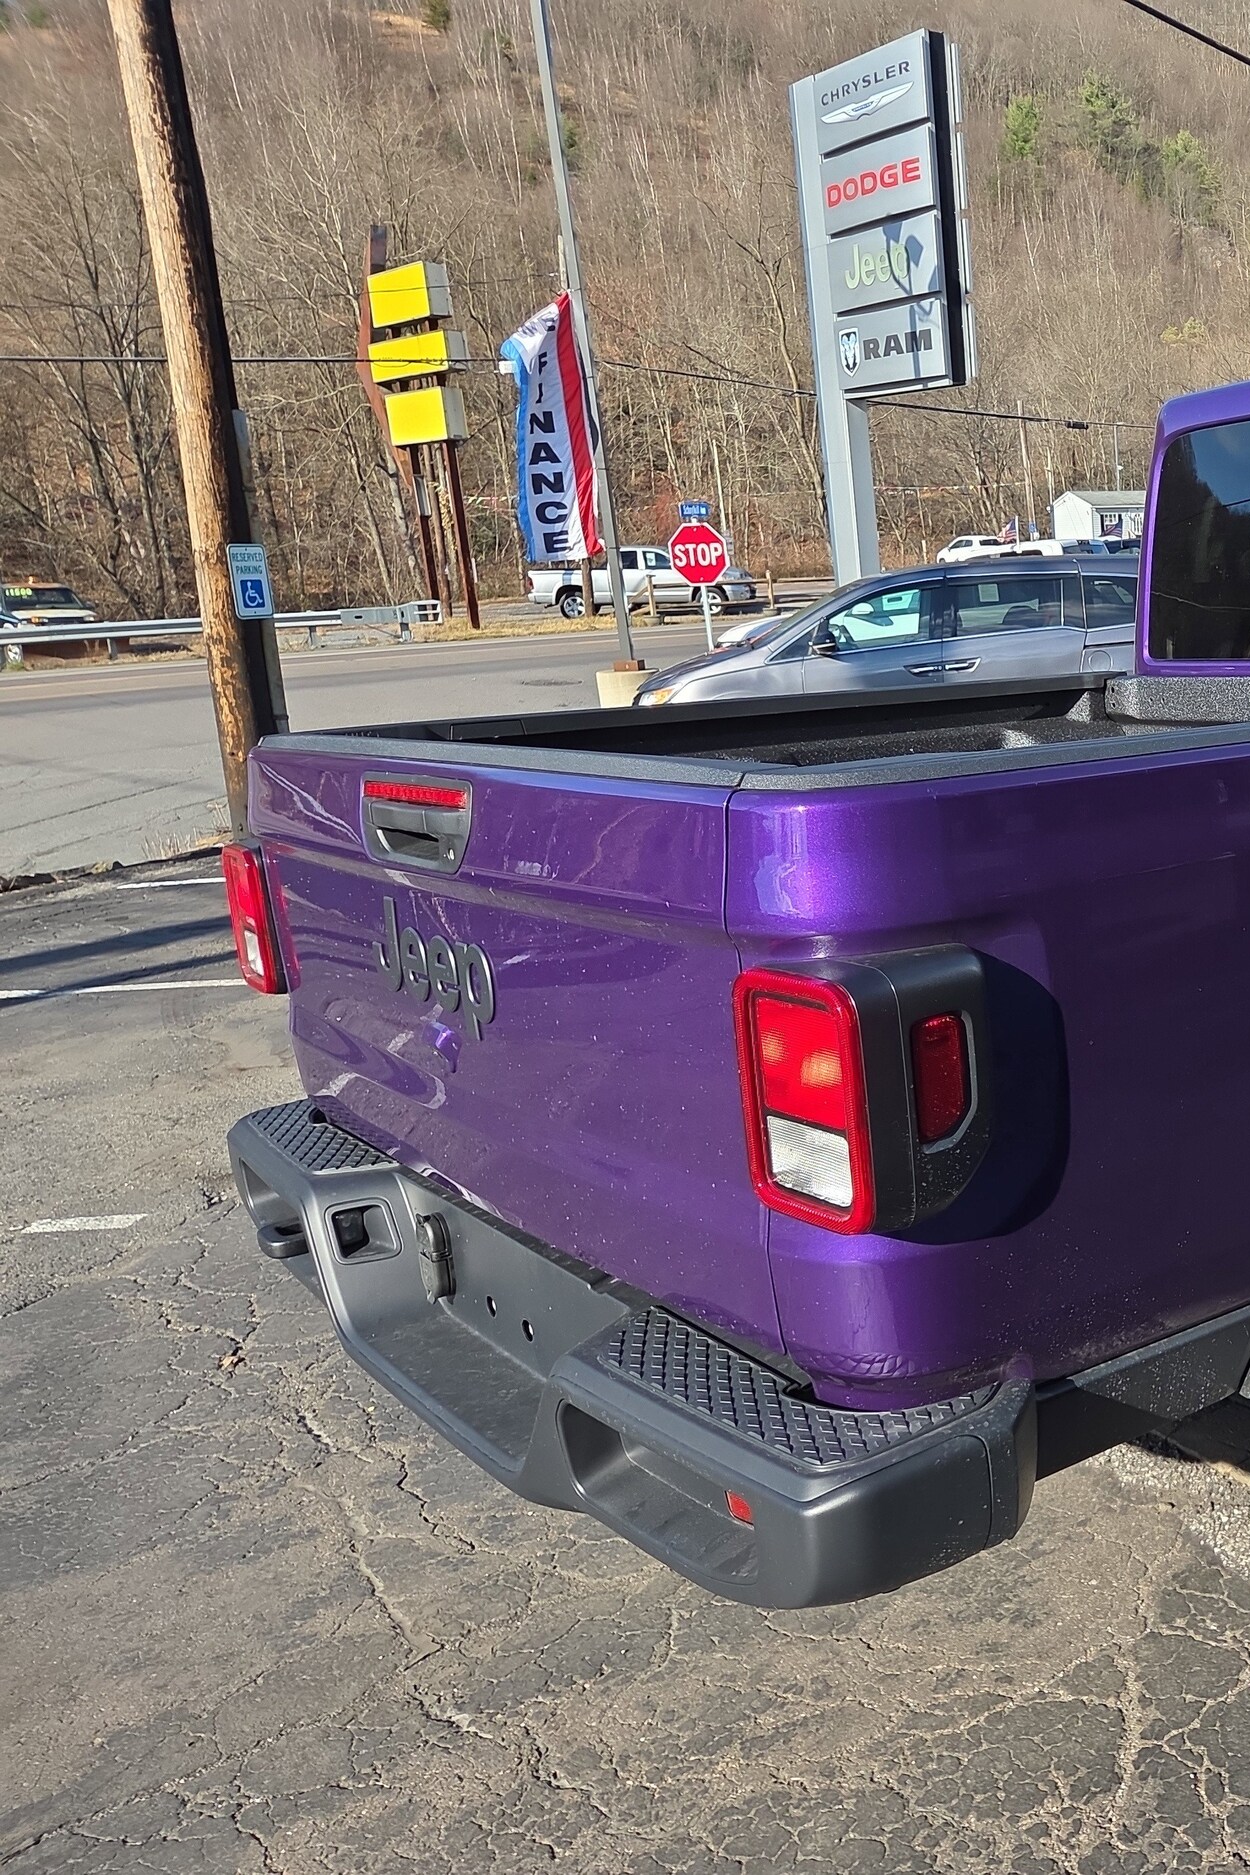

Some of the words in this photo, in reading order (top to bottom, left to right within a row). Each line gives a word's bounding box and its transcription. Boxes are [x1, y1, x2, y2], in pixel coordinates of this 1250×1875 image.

[821, 61, 911, 106] CHRYSLER
[827, 158, 921, 208] DODGE
[845, 244, 910, 290] Jeep
[864, 328, 933, 361] RAM
[529, 351, 569, 554] FINANCE
[231, 552, 263, 562] RESERVED
[235, 565, 263, 575] PARKING
[673, 542, 723, 568] STOP
[372, 896, 496, 1041] Jeep
